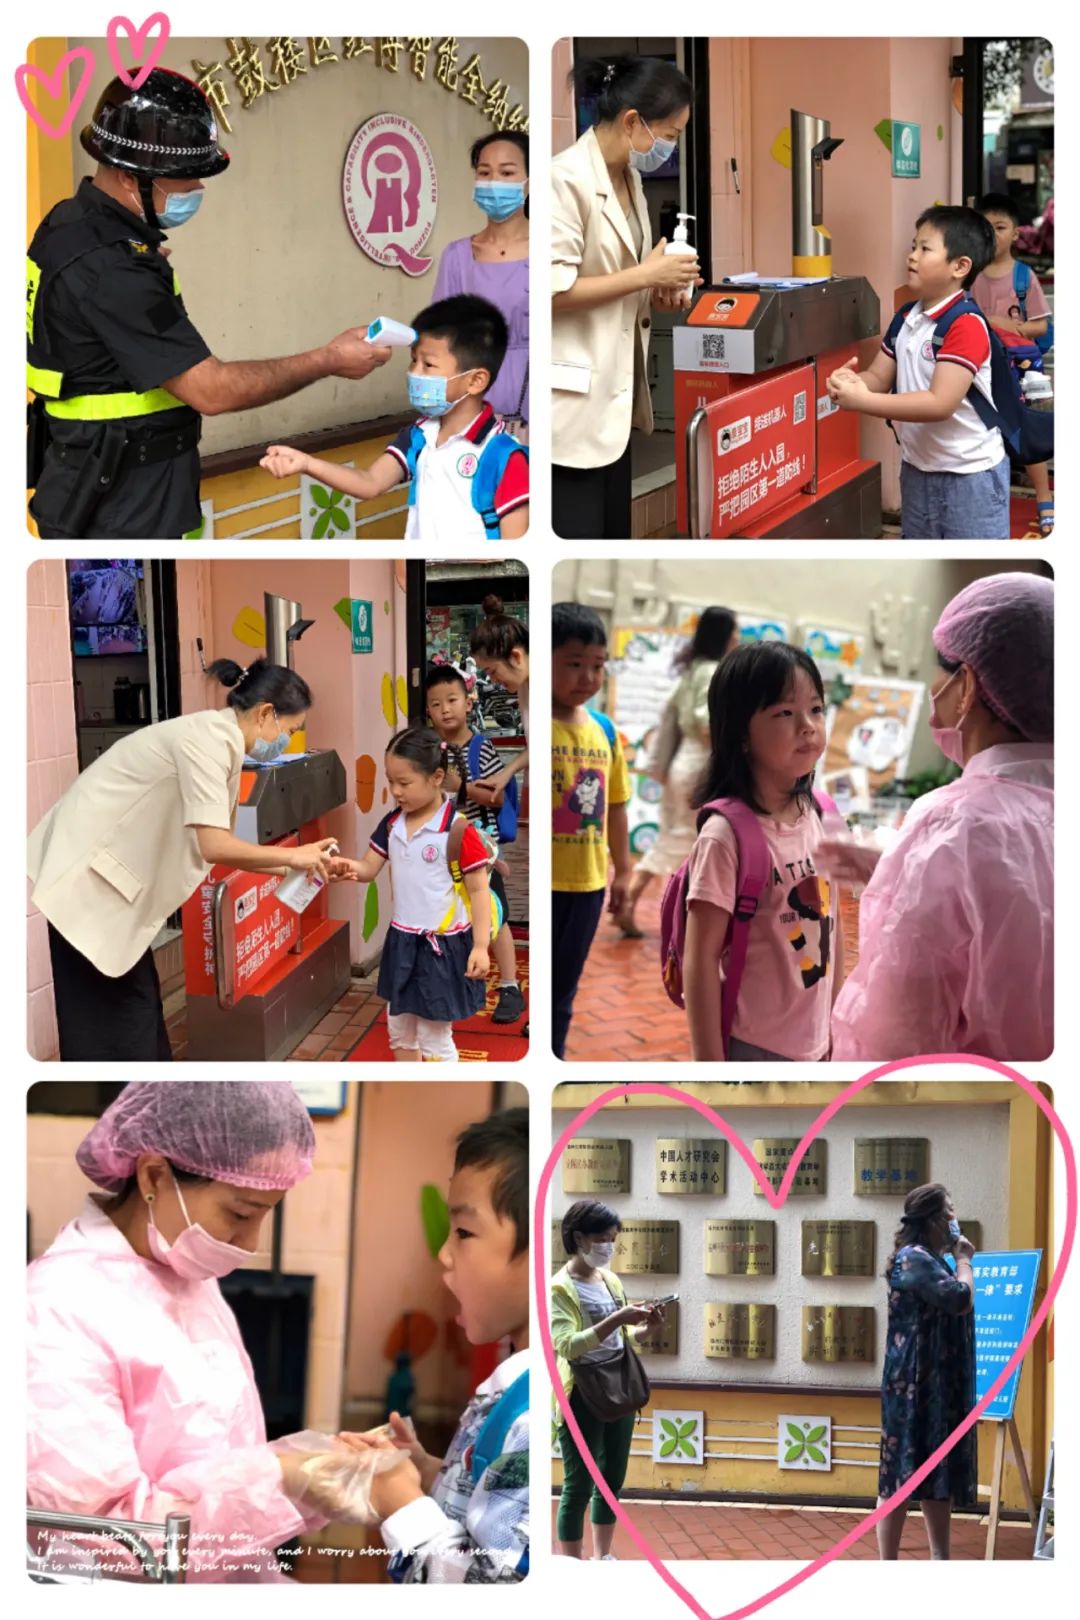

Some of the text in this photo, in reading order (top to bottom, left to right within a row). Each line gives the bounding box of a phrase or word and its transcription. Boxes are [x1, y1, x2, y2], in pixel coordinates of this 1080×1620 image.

[345, 128, 368, 192] CAPABILITY
[368, 116, 407, 131] INCLUSIVE
[410, 221, 431, 255] FUZHOU
[660, 1150, 720, 1163] 中国人才研究会
[660, 1170, 720, 1184] 学术活动中心
